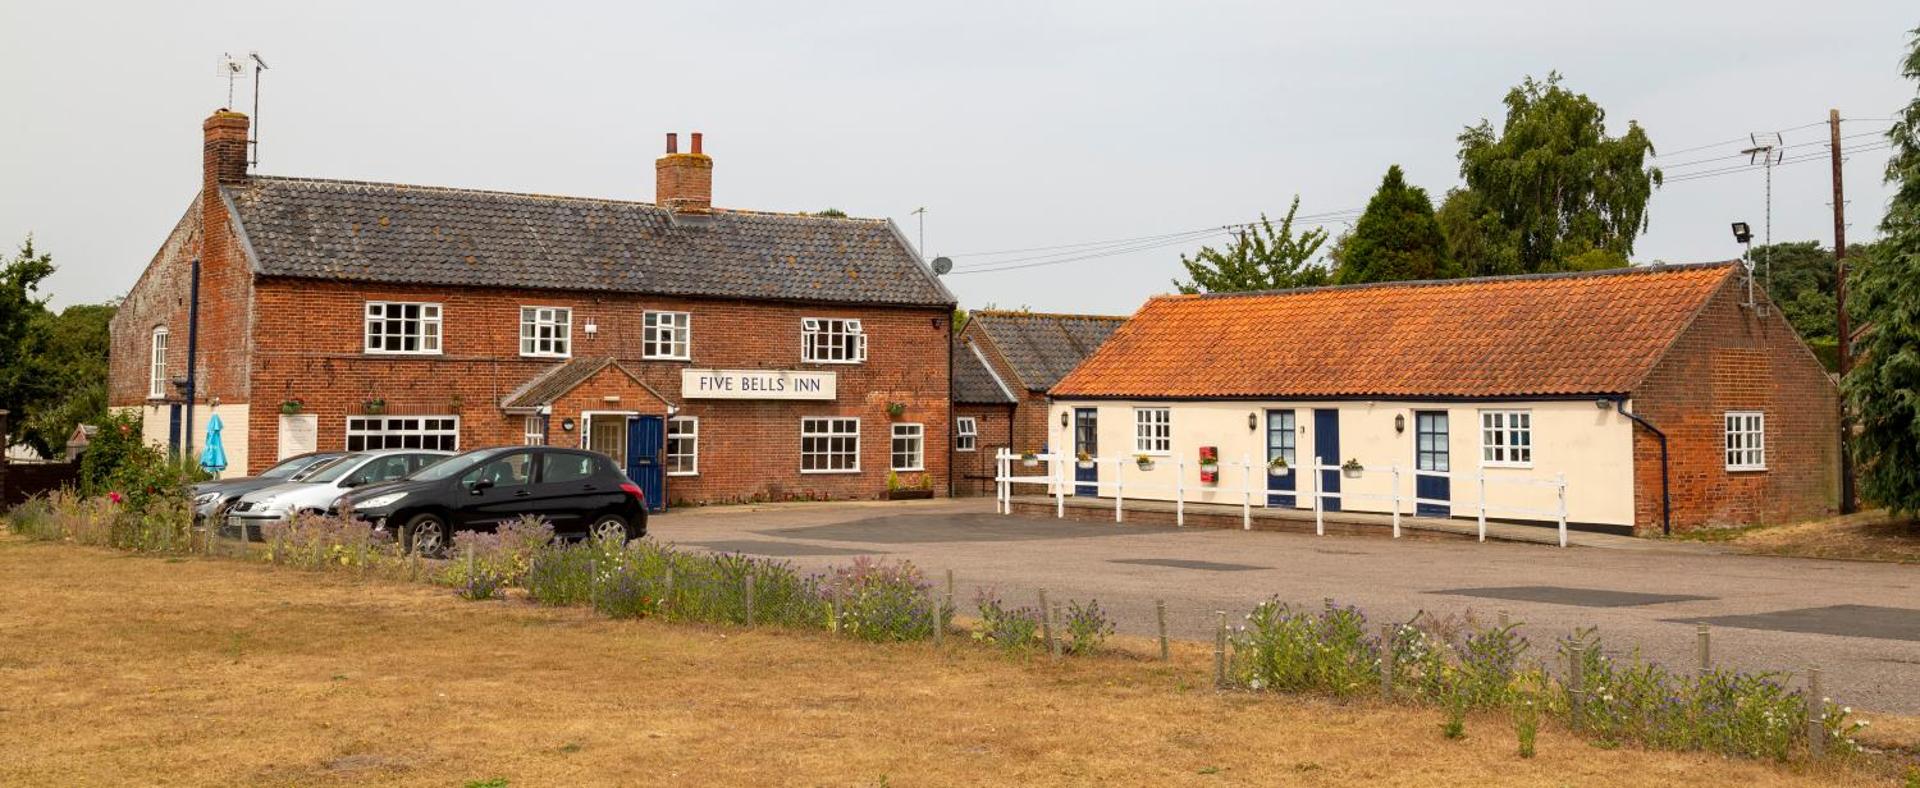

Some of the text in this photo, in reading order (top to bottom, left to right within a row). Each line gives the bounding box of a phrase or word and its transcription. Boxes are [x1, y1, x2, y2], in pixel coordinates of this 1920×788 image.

[700, 377, 820, 392] FIVE BELLS INN
